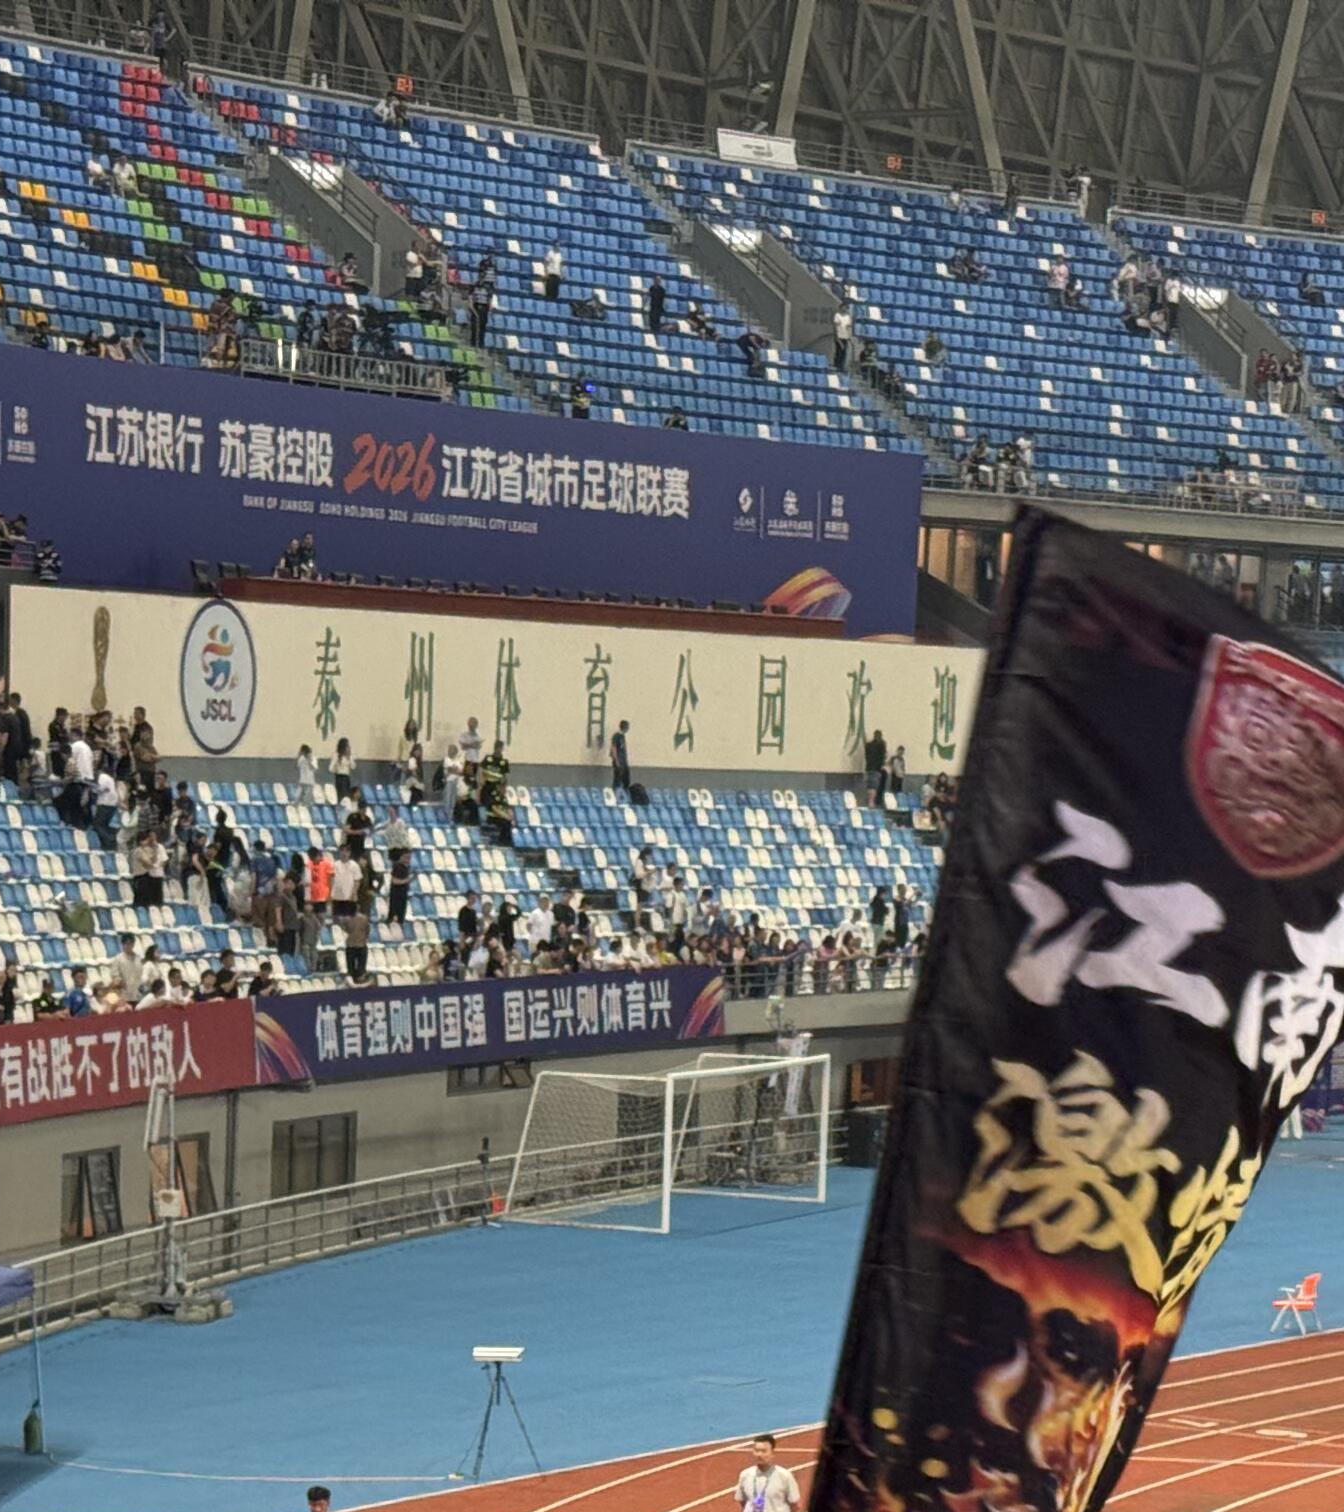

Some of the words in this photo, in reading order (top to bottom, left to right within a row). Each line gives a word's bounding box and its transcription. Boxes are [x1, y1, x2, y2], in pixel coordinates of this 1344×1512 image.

[85, 403, 202, 473] 江苏银行
[218, 420, 333, 487] 苏豪控股
[343, 432, 436, 500] 2026
[441, 444, 690, 519] 江苏省城市足球联赛
[200, 699, 236, 722] JSCL
[316, 993, 487, 1062] 体育强则中国强
[504, 979, 672, 1042] 国运兴则体育兴
